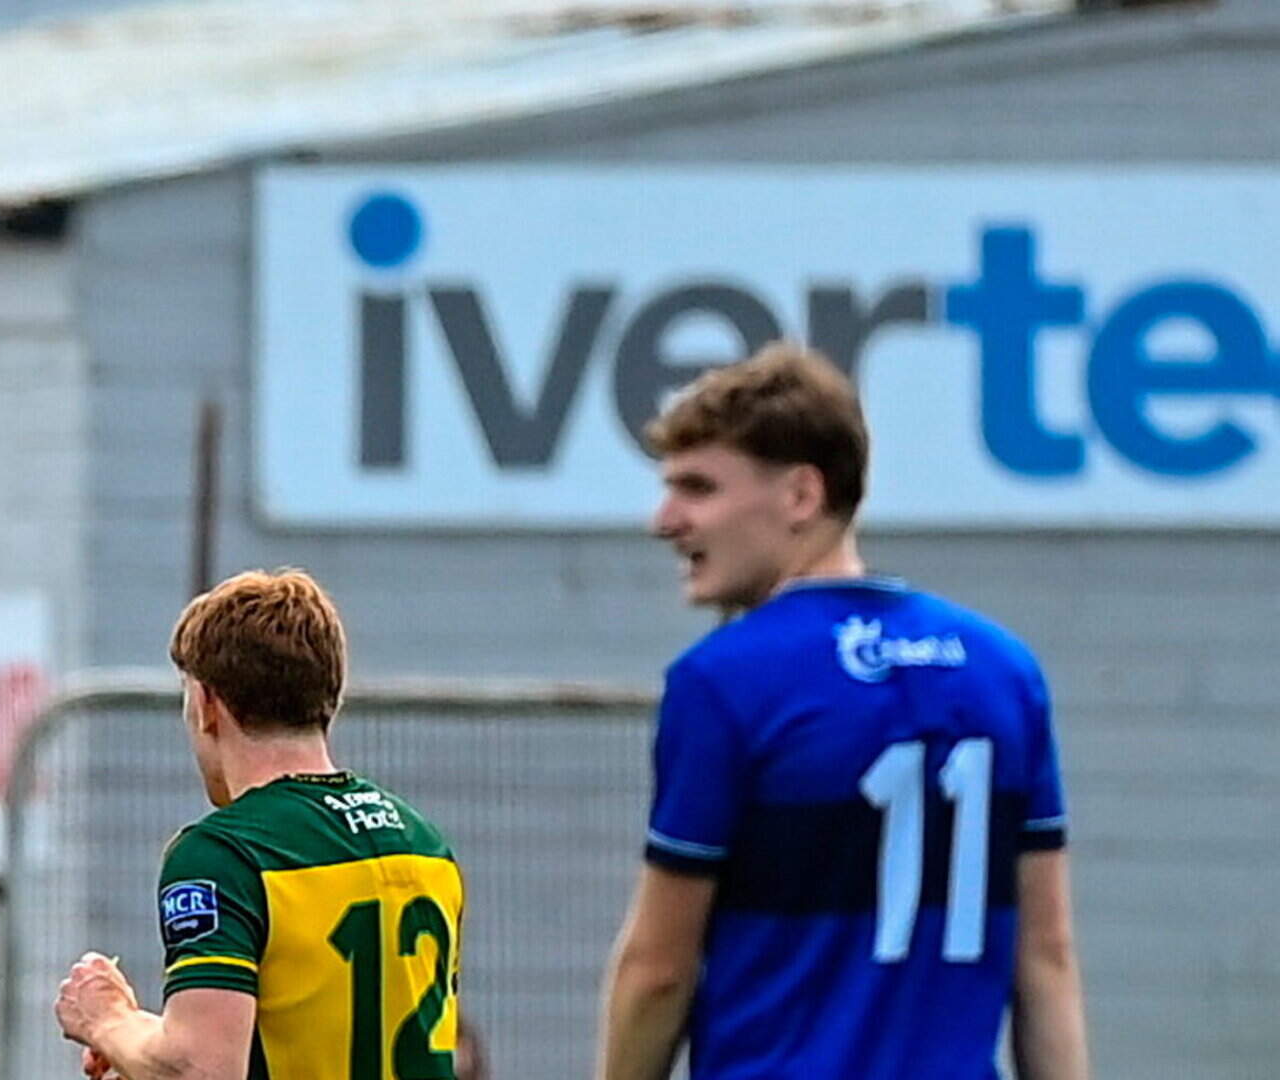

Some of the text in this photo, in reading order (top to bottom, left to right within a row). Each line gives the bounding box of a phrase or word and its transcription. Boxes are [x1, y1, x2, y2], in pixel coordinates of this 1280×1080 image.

[350, 195, 1280, 479] iverte
[161, 891, 207, 918] MCR
[858, 736, 993, 963] 11
